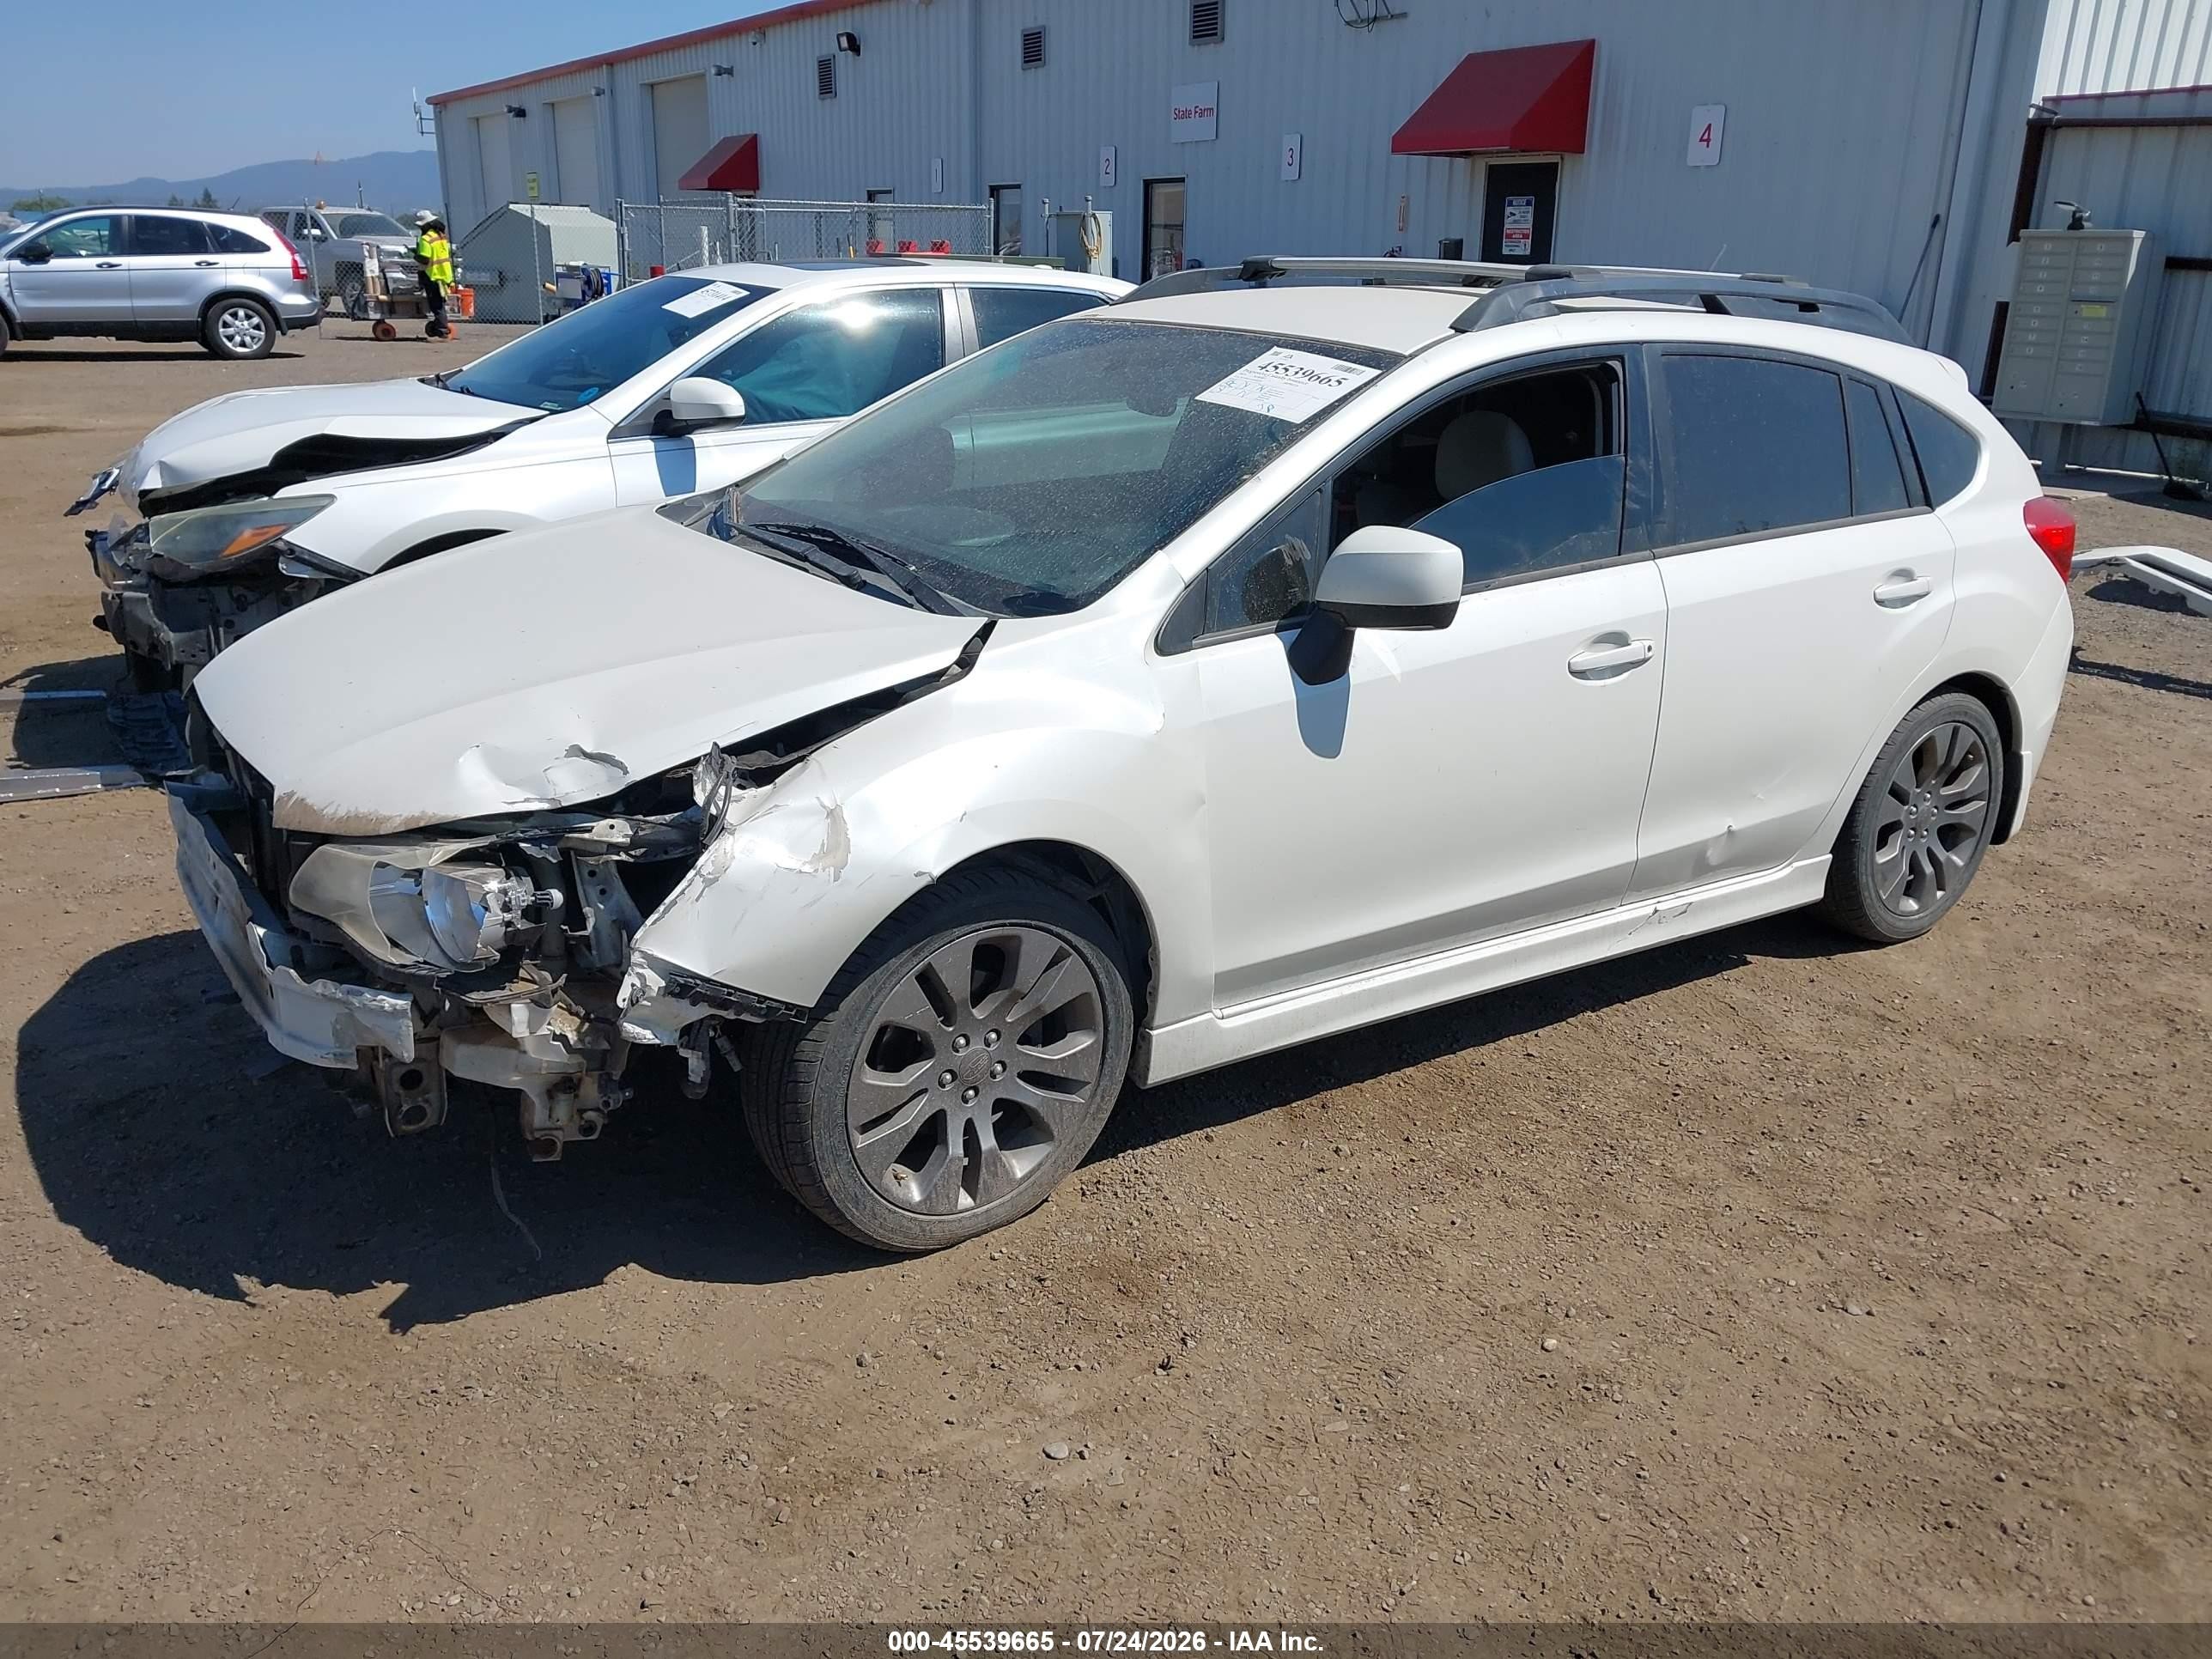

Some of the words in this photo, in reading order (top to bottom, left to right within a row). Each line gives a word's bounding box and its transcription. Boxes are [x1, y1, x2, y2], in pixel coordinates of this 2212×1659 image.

[1173, 106, 1193, 121] State
[1194, 104, 1214, 119] Farm
[1698, 123, 1712, 149] 4
[1104, 157, 1110, 175] 2
[1286, 147, 1294, 167] 3
[1257, 361, 1350, 388] 45539665
